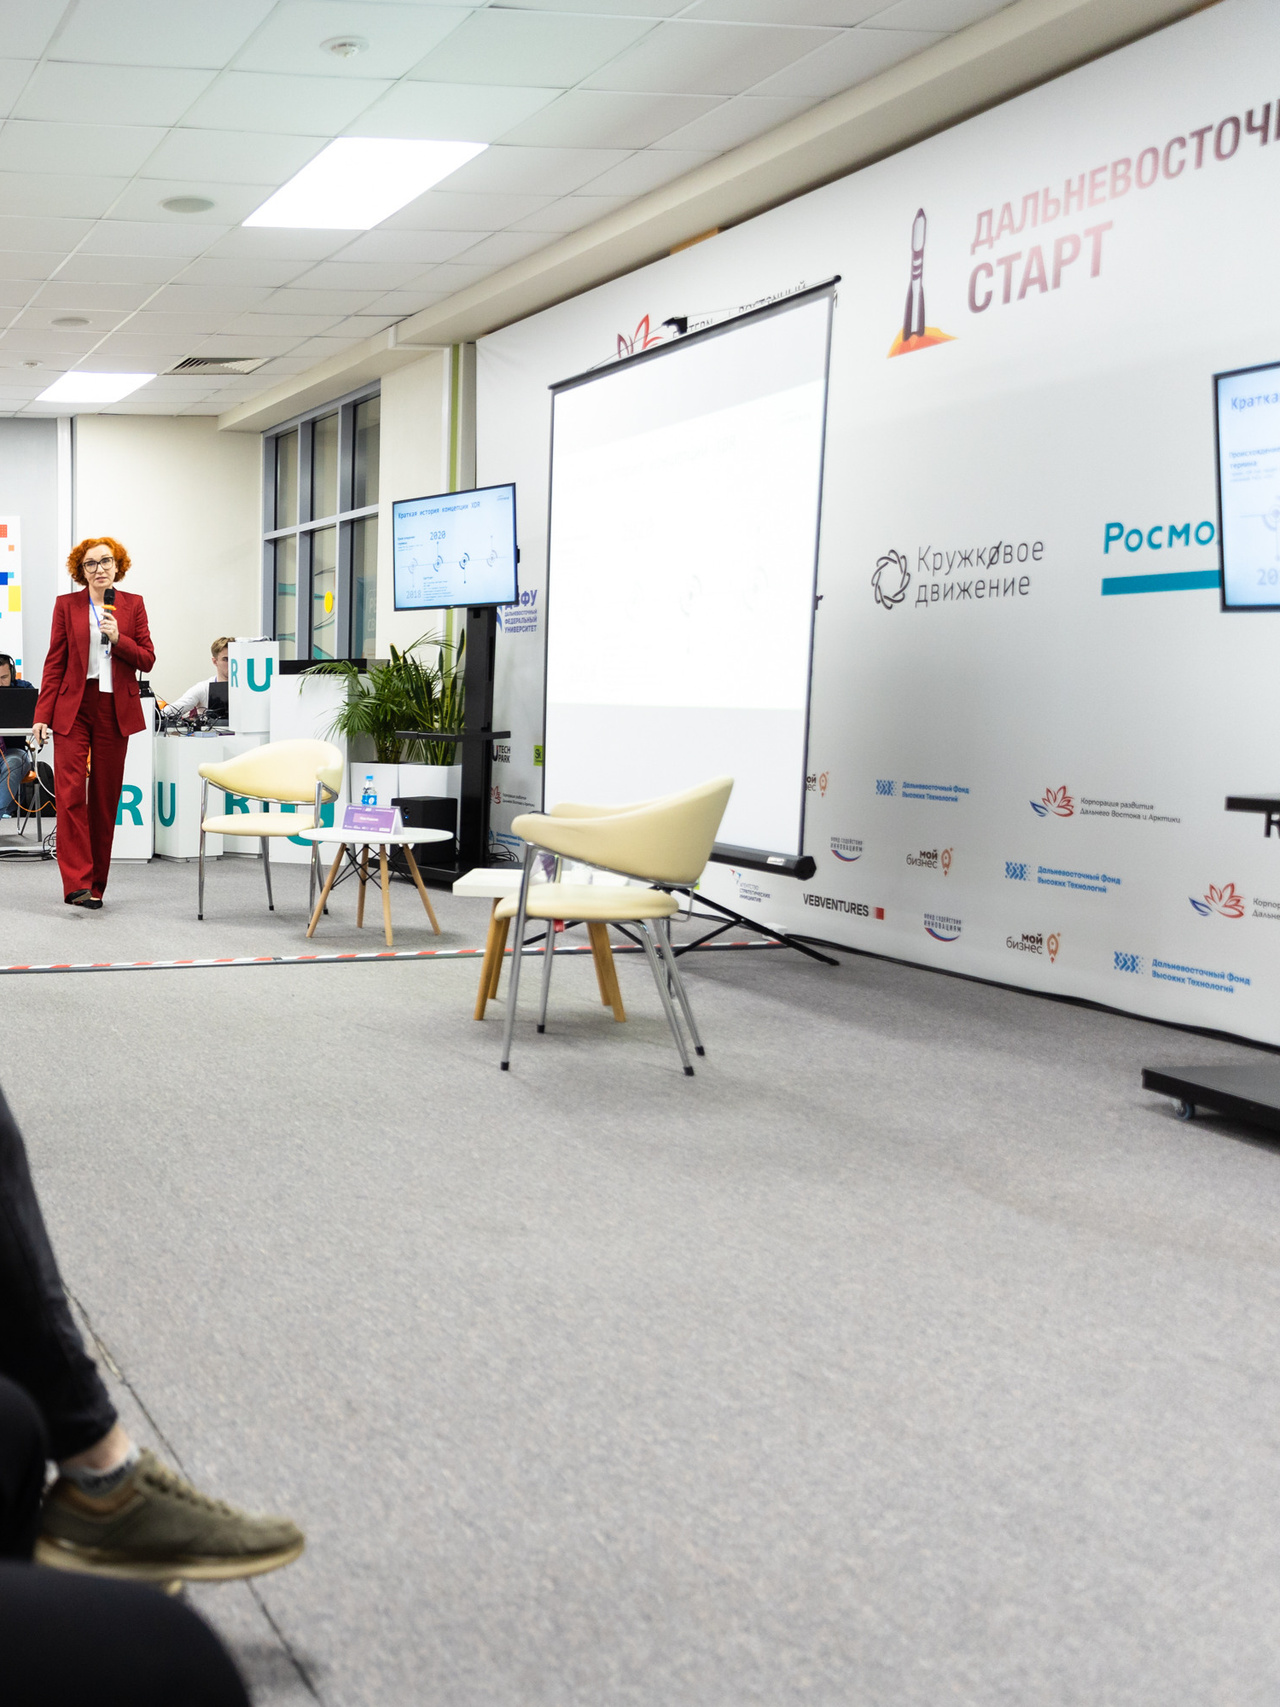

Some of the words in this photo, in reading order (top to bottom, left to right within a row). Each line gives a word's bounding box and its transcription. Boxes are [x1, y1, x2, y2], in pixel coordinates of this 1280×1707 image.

[970, 98, 1280, 255] ДАЛЬНЕВОСТОЧ
[968, 220, 1114, 314] СТАРТ
[430, 530, 446, 540] 2020
[1103, 521, 1220, 554] Росмо
[915, 576, 1030, 608] движение
[499, 745, 511, 754] TECH
[498, 754, 511, 763] PARK
[805, 774, 817, 784] ой
[1081, 798, 1119, 807] Корпорация
[1120, 802, 1154, 810] развития
[1080, 808, 1109, 816] Дальнего
[1149, 814, 1181, 823] Арктики
[906, 854, 938, 869] бизнес
[920, 849, 938, 860] мой
[1038, 866, 1100, 881] Дальневосточный
[1101, 874, 1122, 885] Фонд
[1067, 881, 1107, 893] Технологий
[803, 893, 869, 917] VEBVENTURES
[1006, 936, 1042, 954] бизнес
[1022, 933, 1042, 945] мой
[1152, 959, 1225, 979] Дальневосточный
[1227, 973, 1250, 986] Фонд
[1152, 970, 1185, 984] Высоких
[1187, 977, 1234, 993] Технологий
